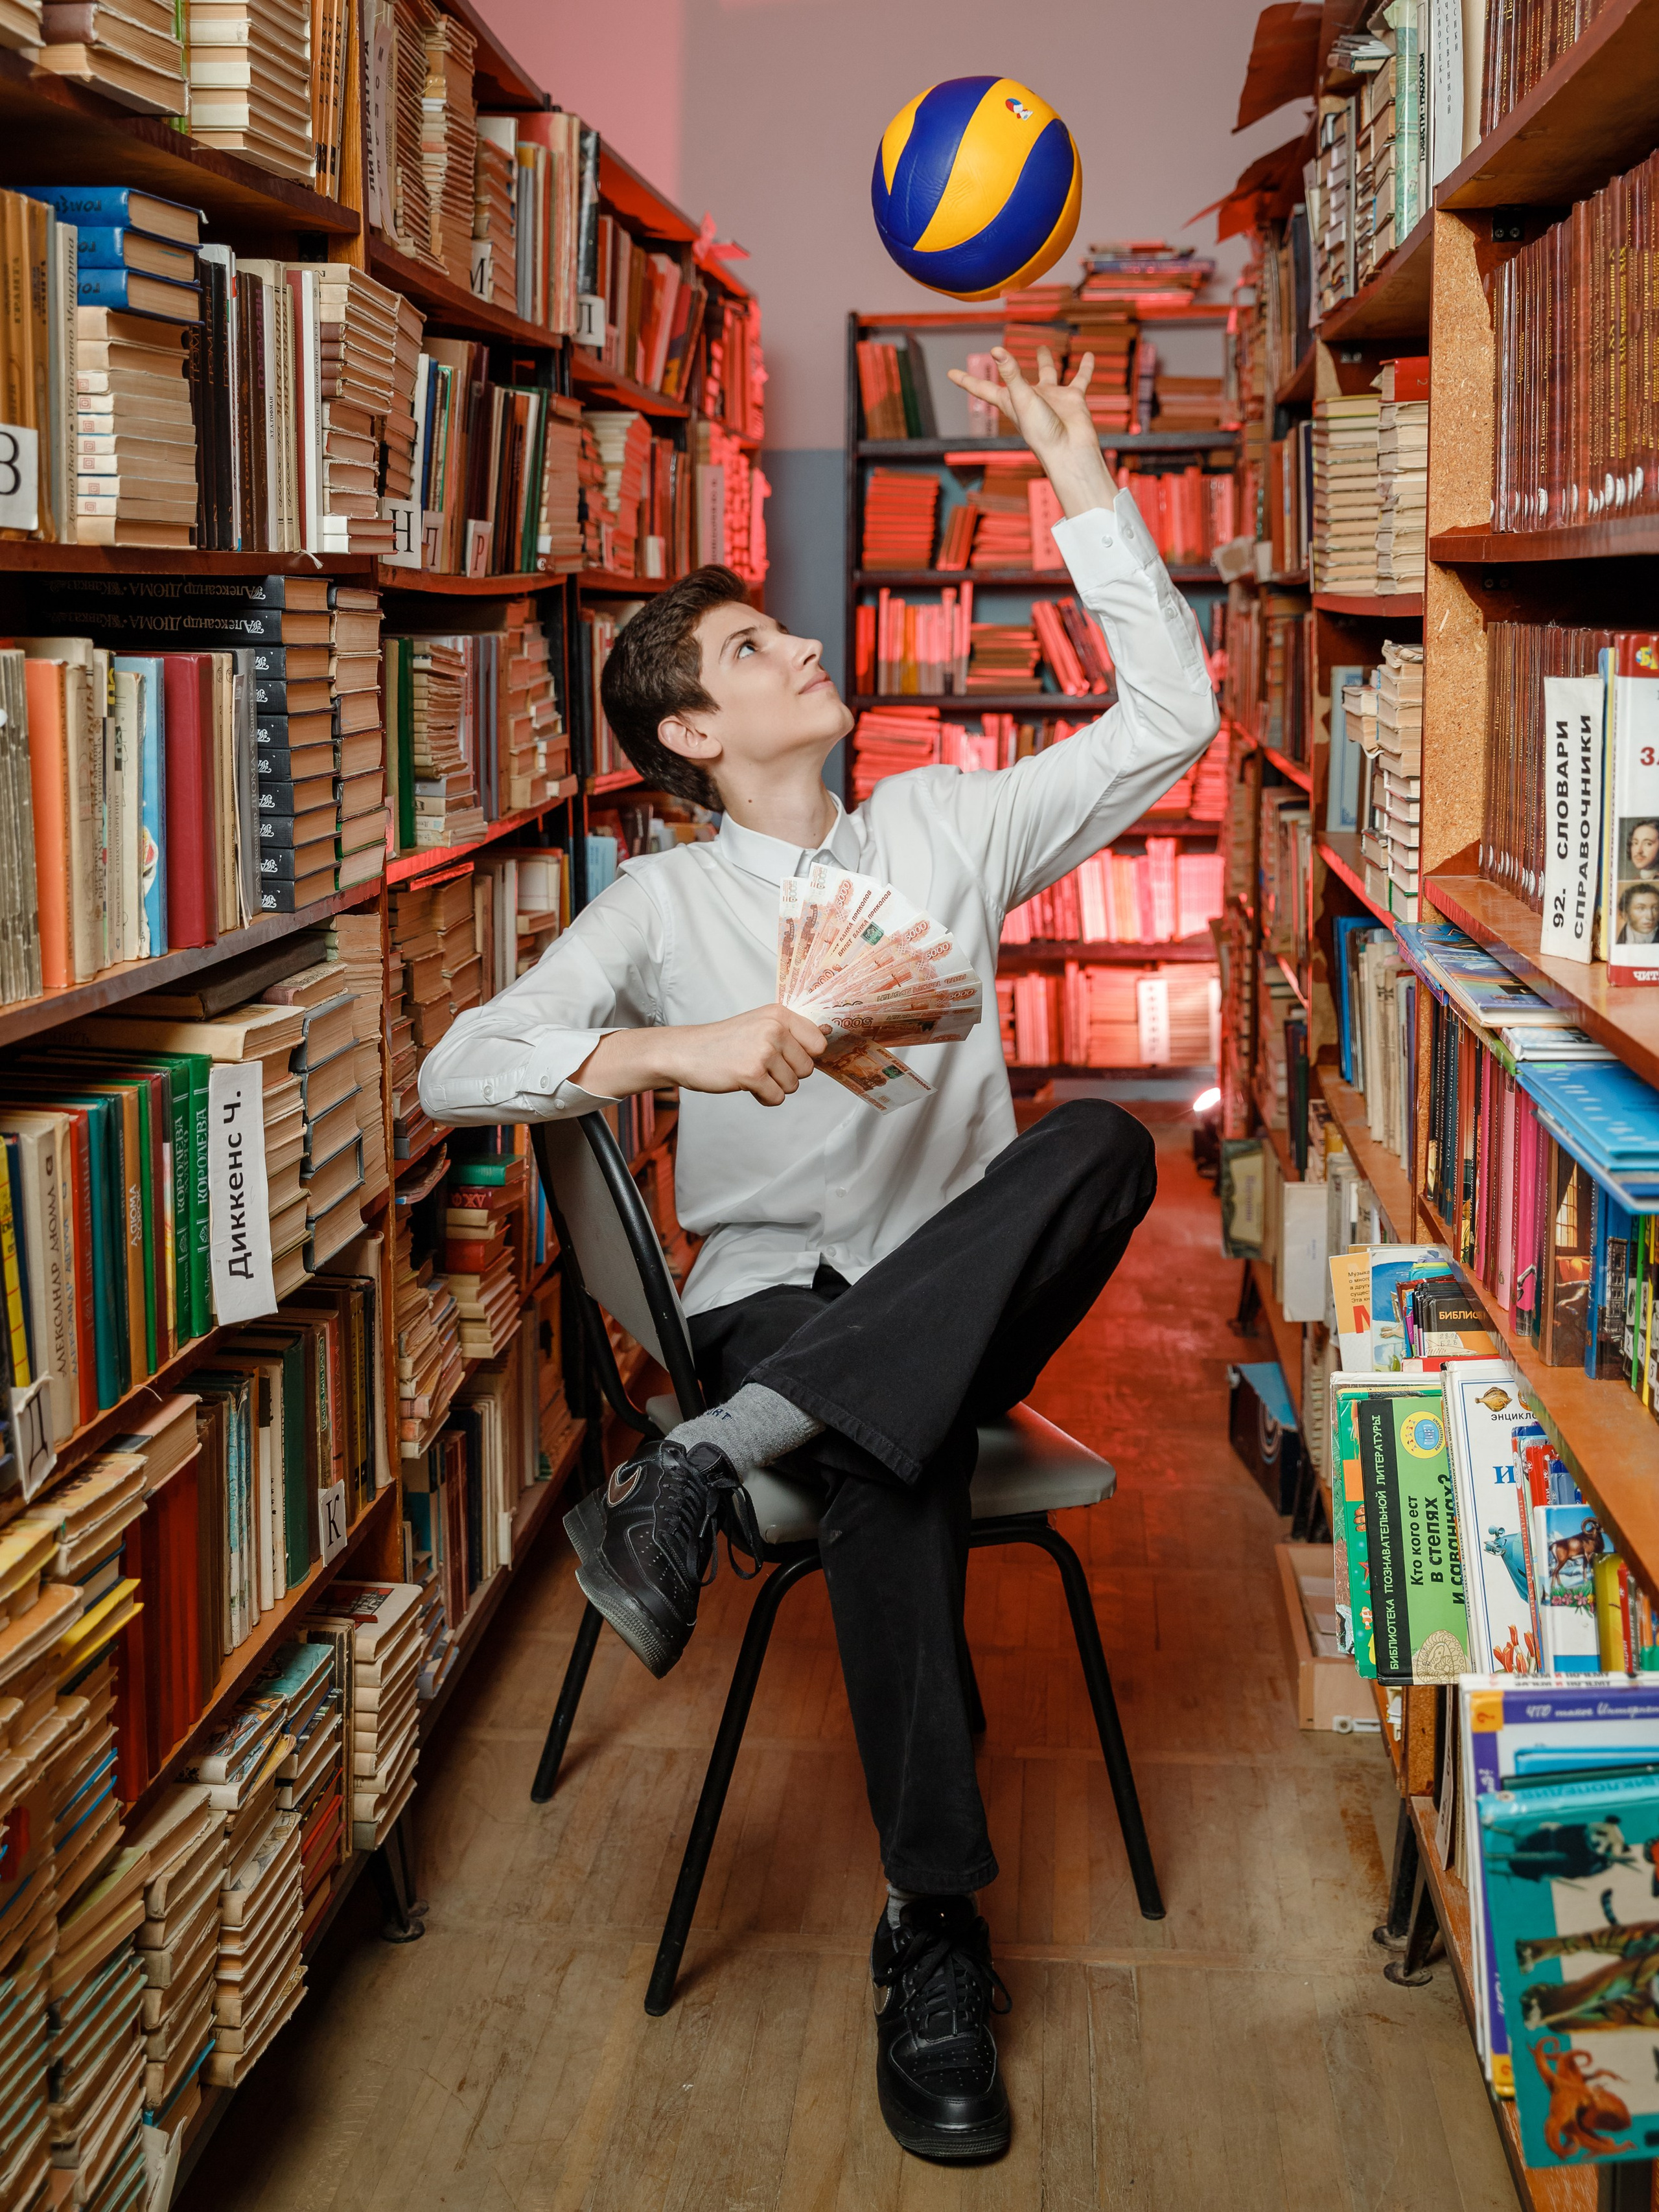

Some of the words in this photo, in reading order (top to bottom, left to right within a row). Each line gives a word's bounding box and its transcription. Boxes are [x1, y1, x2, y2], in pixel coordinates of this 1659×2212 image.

[333, 15, 342, 85] БРЕХТ
[364, 40, 376, 193] ЛИТЕРАТУРА
[66, 236, 76, 326] Моцарта
[65, 330, 76, 420] Убийство
[388, 509, 414, 553] Н
[472, 534, 484, 570] Р
[129, 582, 182, 598] ДЮМА
[183, 584, 255, 599] Александр
[129, 615, 182, 631] ДЮМА
[183, 616, 255, 631] Александр
[1556, 720, 1569, 860] СЛОВАРИ
[1573, 715, 1592, 940] СПРАВОЧНИКИ
[838, 939, 853, 957] БИЛЕТ
[853, 919, 868, 939] БАНКА
[867, 890, 892, 920] ПРИКОЛОВ
[840, 921, 853, 942] БАНКА
[852, 890, 872, 921] ПРИКОЛОВ
[1553, 886, 1566, 929] 92.
[905, 922, 928, 941] 5000
[926, 942, 950, 960] 5000
[949, 989, 975, 1000] 5000
[831, 1017, 874, 1028] 5000
[892, 1059, 908, 1072] БАНКА
[907, 1072, 932, 1091] ПРИКОЛОВ
[222, 1090, 242, 1125] Ч.
[174, 1115, 185, 1215] КОРОЛЕВА
[196, 1107, 209, 1206] КОРОЛЕВА
[227, 1133, 254, 1280] Диккенс
[51, 1262, 67, 1378] АЛЕКСАНДР
[27, 1386, 49, 1482] Д
[1371, 1415, 1386, 1486] ЛИТЕРАТУРЫ
[1422, 1423, 1435, 1446] ПЛАНЕТА
[1432, 1418, 1444, 1451] ЛЮБОЗНАТЕЛЬНЫХ
[1443, 1381, 1453, 1442] ЭНЦИКЛОПЕДИЯ
[1448, 1442, 1458, 1501] ОКРУЖАЮЩЕГО
[1492, 1466, 1516, 1484] И
[326, 1493, 341, 1547] К
[1406, 1496, 1419, 1519] ест
[1375, 1491, 1395, 1595] ПОЗНАВАТЕЛЬНОЙ
[1409, 1521, 1422, 1557] кого
[1423, 1497, 1443, 1567] степях
[1410, 1560, 1424, 1587] Кто
[1431, 1571, 1444, 1584] в
[1452, 1591, 1465, 1605] и
[1386, 1598, 1399, 1671] БИБЛИОТЕКА
